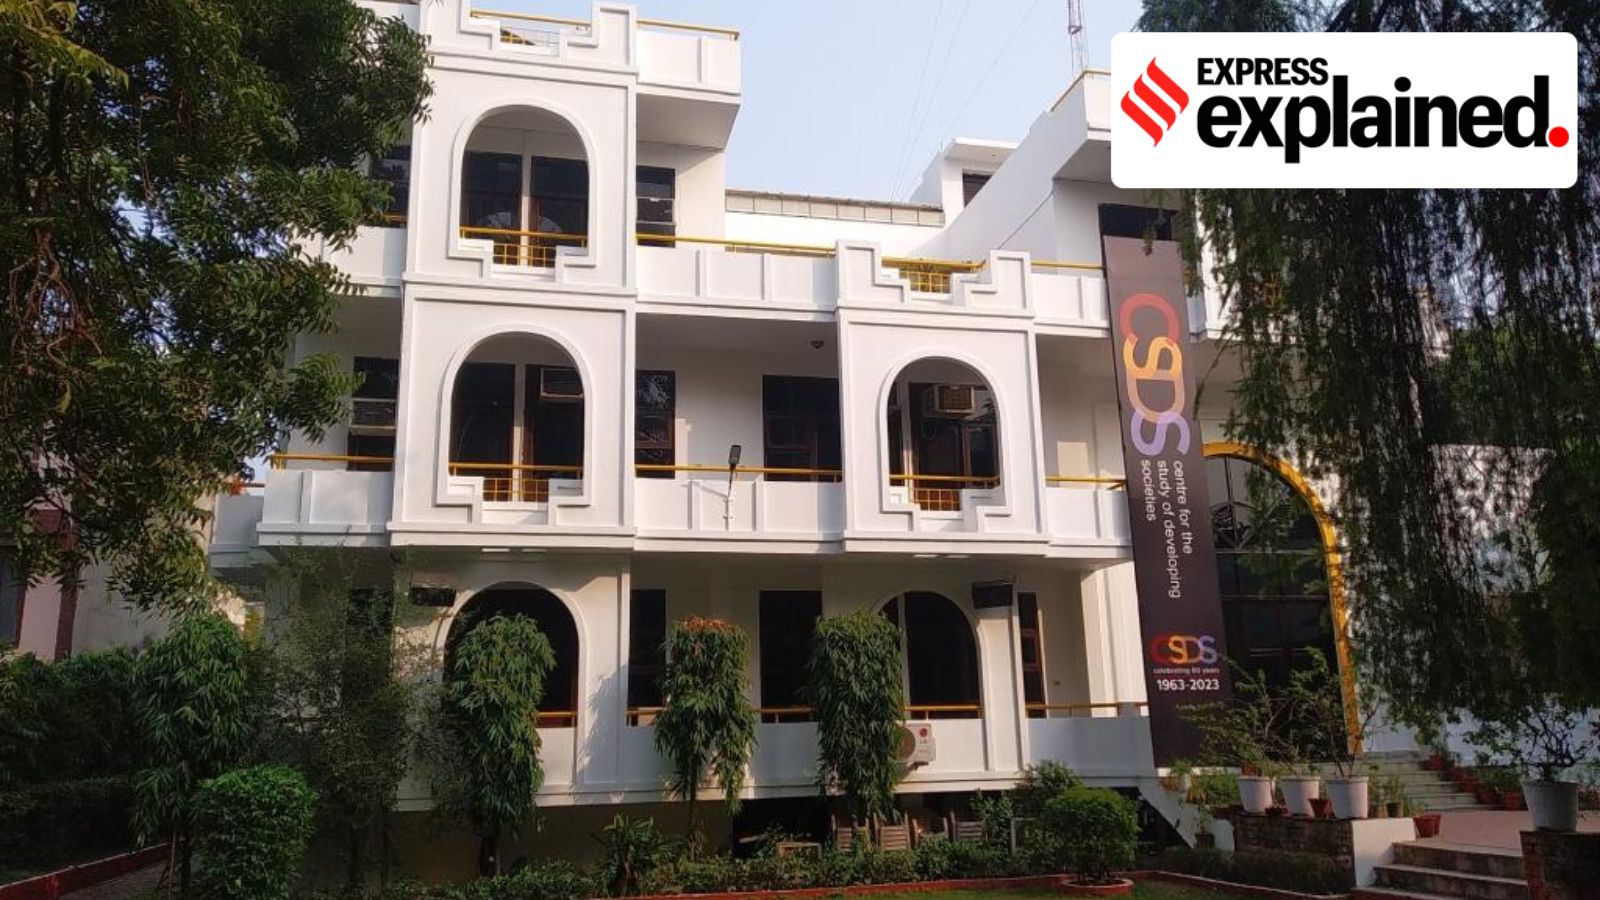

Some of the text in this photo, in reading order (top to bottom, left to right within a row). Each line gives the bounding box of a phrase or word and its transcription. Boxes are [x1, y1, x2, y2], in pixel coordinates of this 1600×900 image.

[1119, 293, 1190, 456] CSDS
[1141, 460, 1157, 521] societies
[1173, 461, 1193, 554] centre for the
[1157, 460, 1181, 598] study of developing
[1151, 634, 1217, 665] CSDS
[1153, 667, 1190, 675] celebrating
[1156, 679, 1220, 691] 1963-2023
